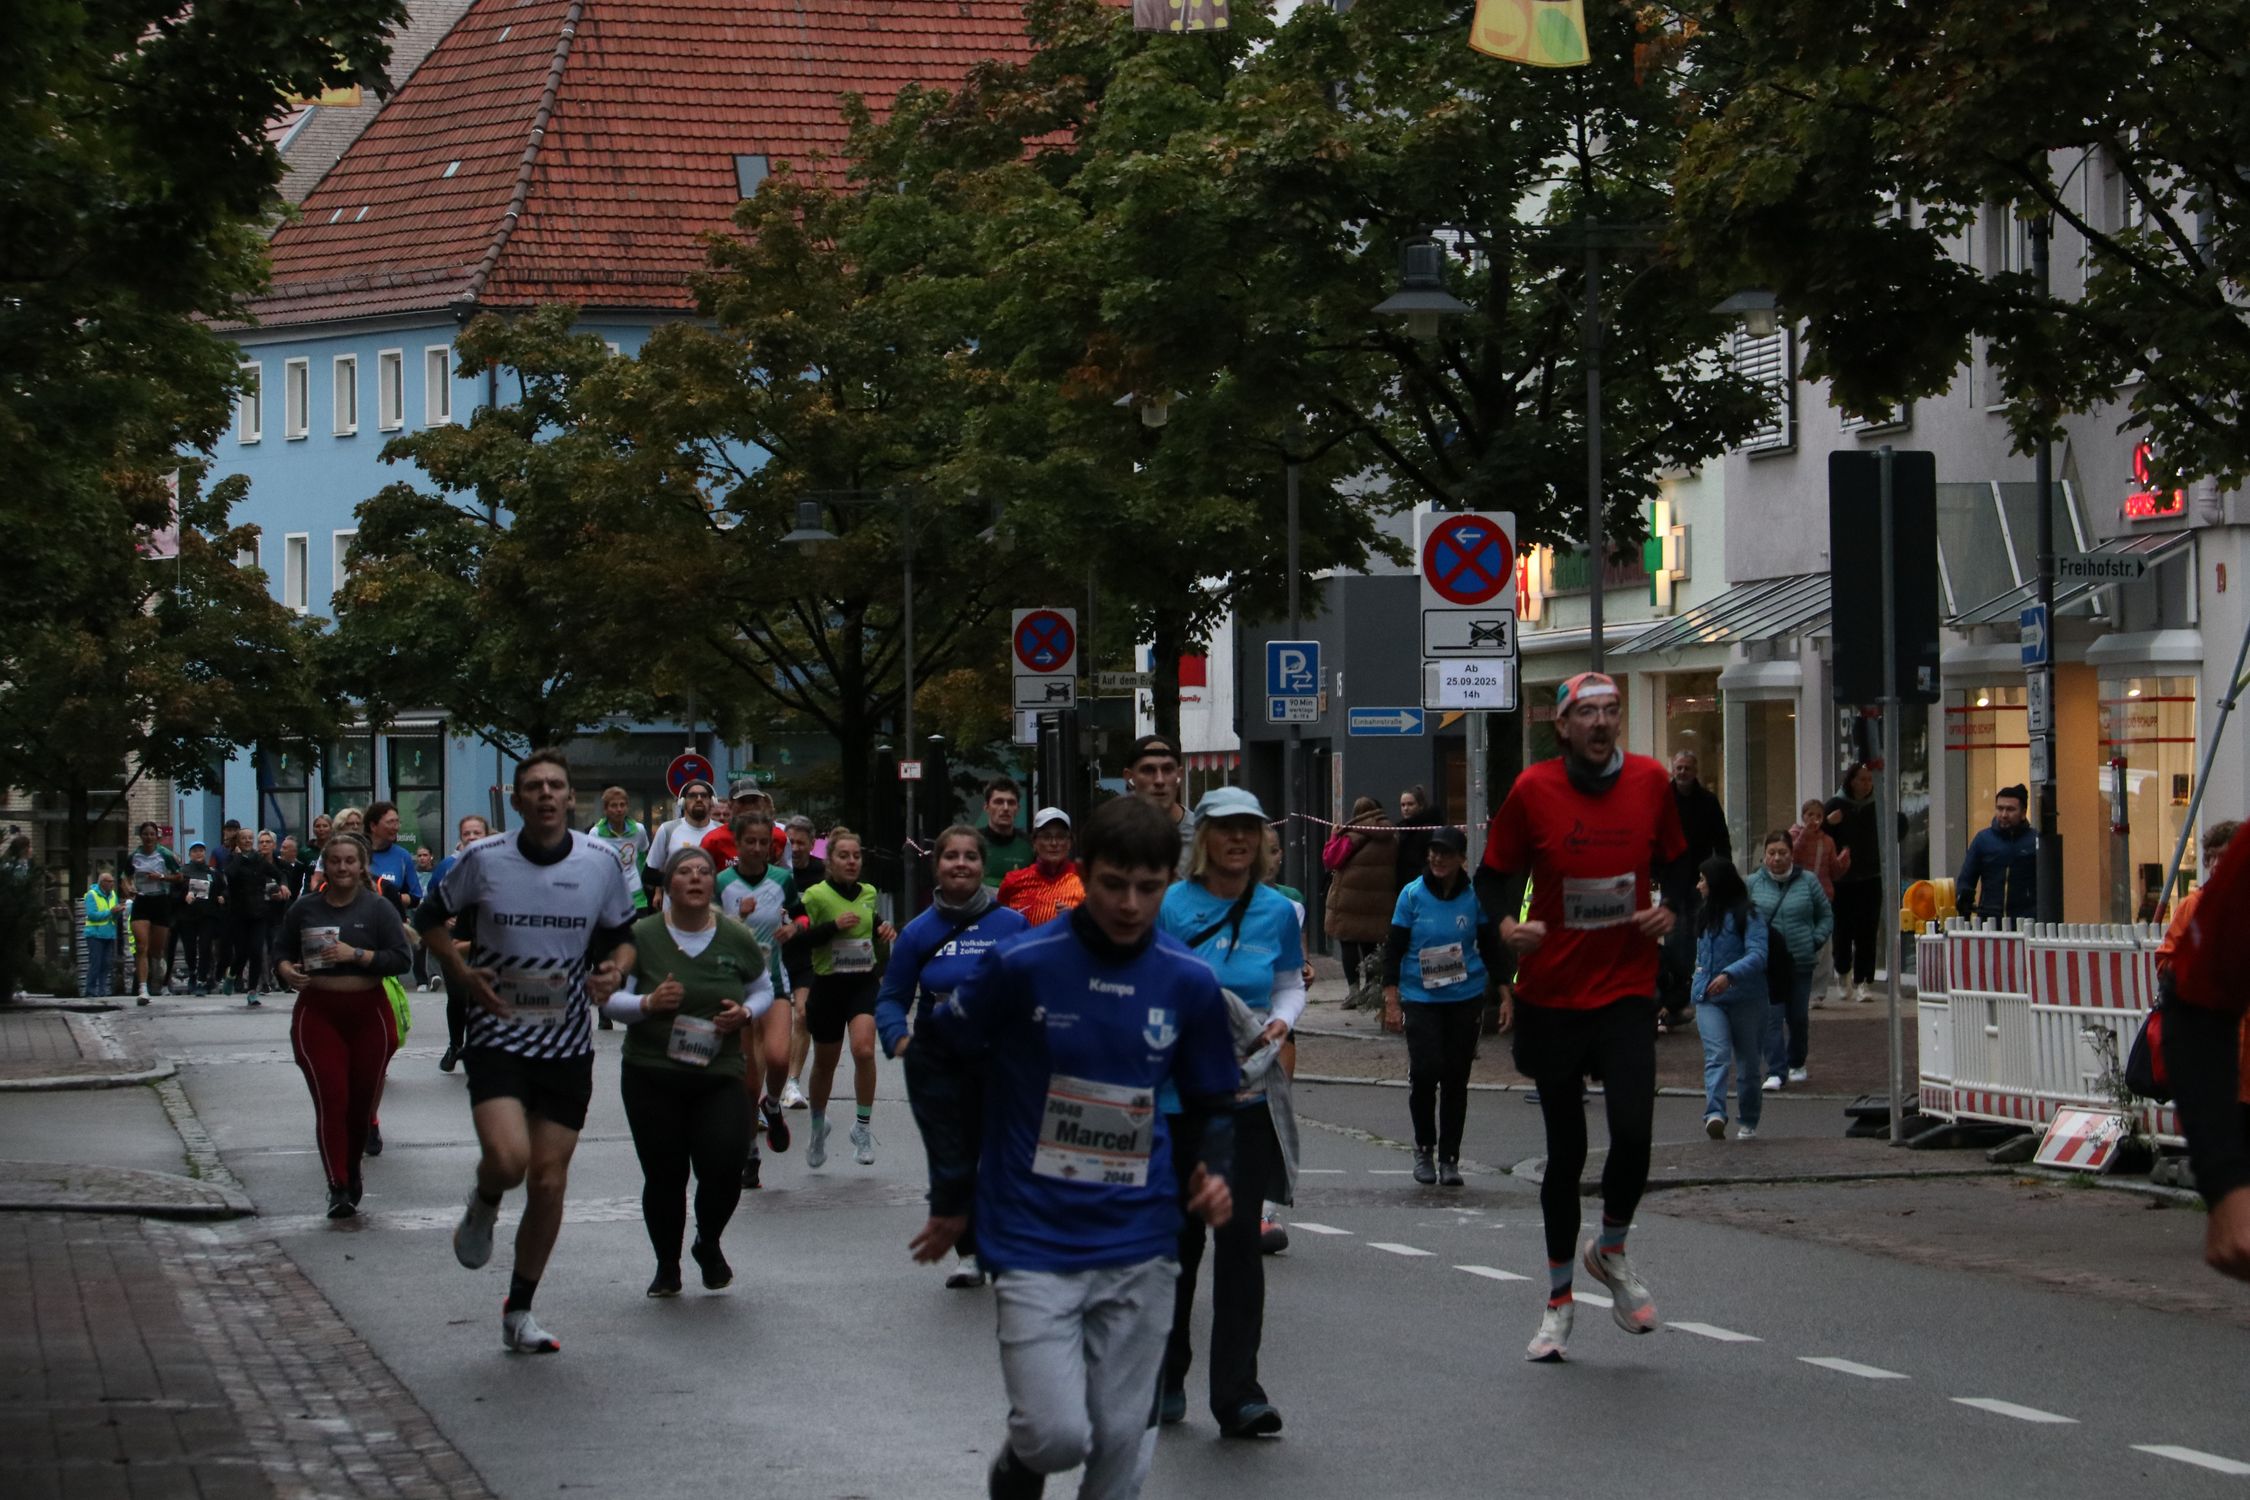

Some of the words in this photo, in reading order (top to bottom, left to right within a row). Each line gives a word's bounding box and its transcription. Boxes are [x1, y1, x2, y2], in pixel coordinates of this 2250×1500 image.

[2060, 558, 2134, 576] Freihofstr.
[1465, 664, 1478, 672] Ab
[1102, 674, 1116, 686] Auf
[1119, 674, 1137, 686] dem
[1446, 677, 1496, 685] 25.09.2025
[1463, 690, 1479, 698] 14h
[1299, 698, 1313, 707] Min
[1353, 716, 1403, 726] Einbahnstraße
[1573, 904, 1625, 920] Fabian
[1421, 960, 1464, 977] Michaela
[1089, 978, 1136, 998] Kempa
[514, 992, 551, 1006] Liam
[1048, 1100, 1084, 1119] 2048
[1056, 1120, 1138, 1151] Marcel
[1102, 1171, 1136, 1184] 2048
